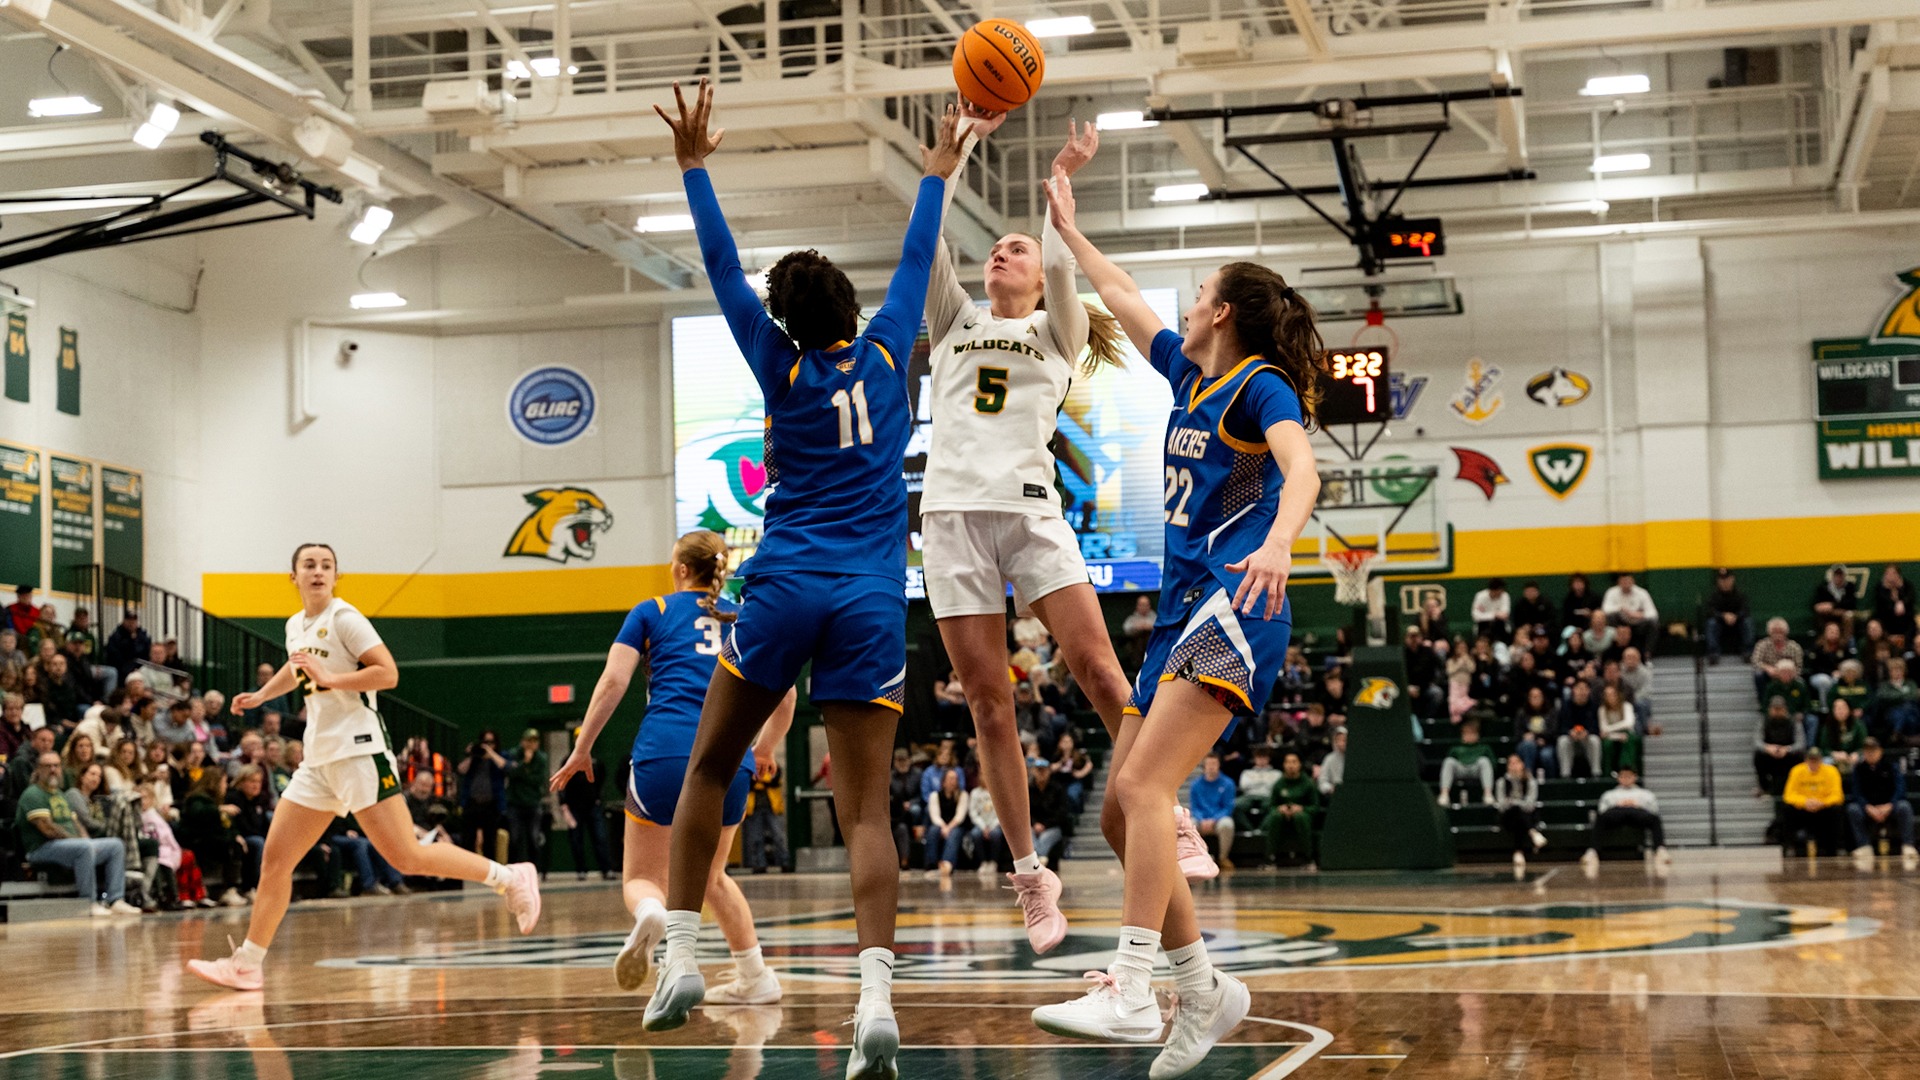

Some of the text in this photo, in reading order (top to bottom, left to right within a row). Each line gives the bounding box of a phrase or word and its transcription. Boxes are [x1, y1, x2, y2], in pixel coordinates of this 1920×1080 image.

[994, 25, 1037, 78] Wilson
[953, 340, 1045, 361] WILDCATS
[1333, 352, 1383, 379] 3:22
[1819, 361, 1891, 380] WILDCATS
[973, 366, 1010, 415] 5
[1352, 376, 1375, 413] 7
[525, 400, 580, 419] GLIAC
[831, 380, 873, 449] 11
[1167, 426, 1211, 459] AKERS
[1164, 465, 1194, 527] 22
[694, 616, 722, 655] 3
